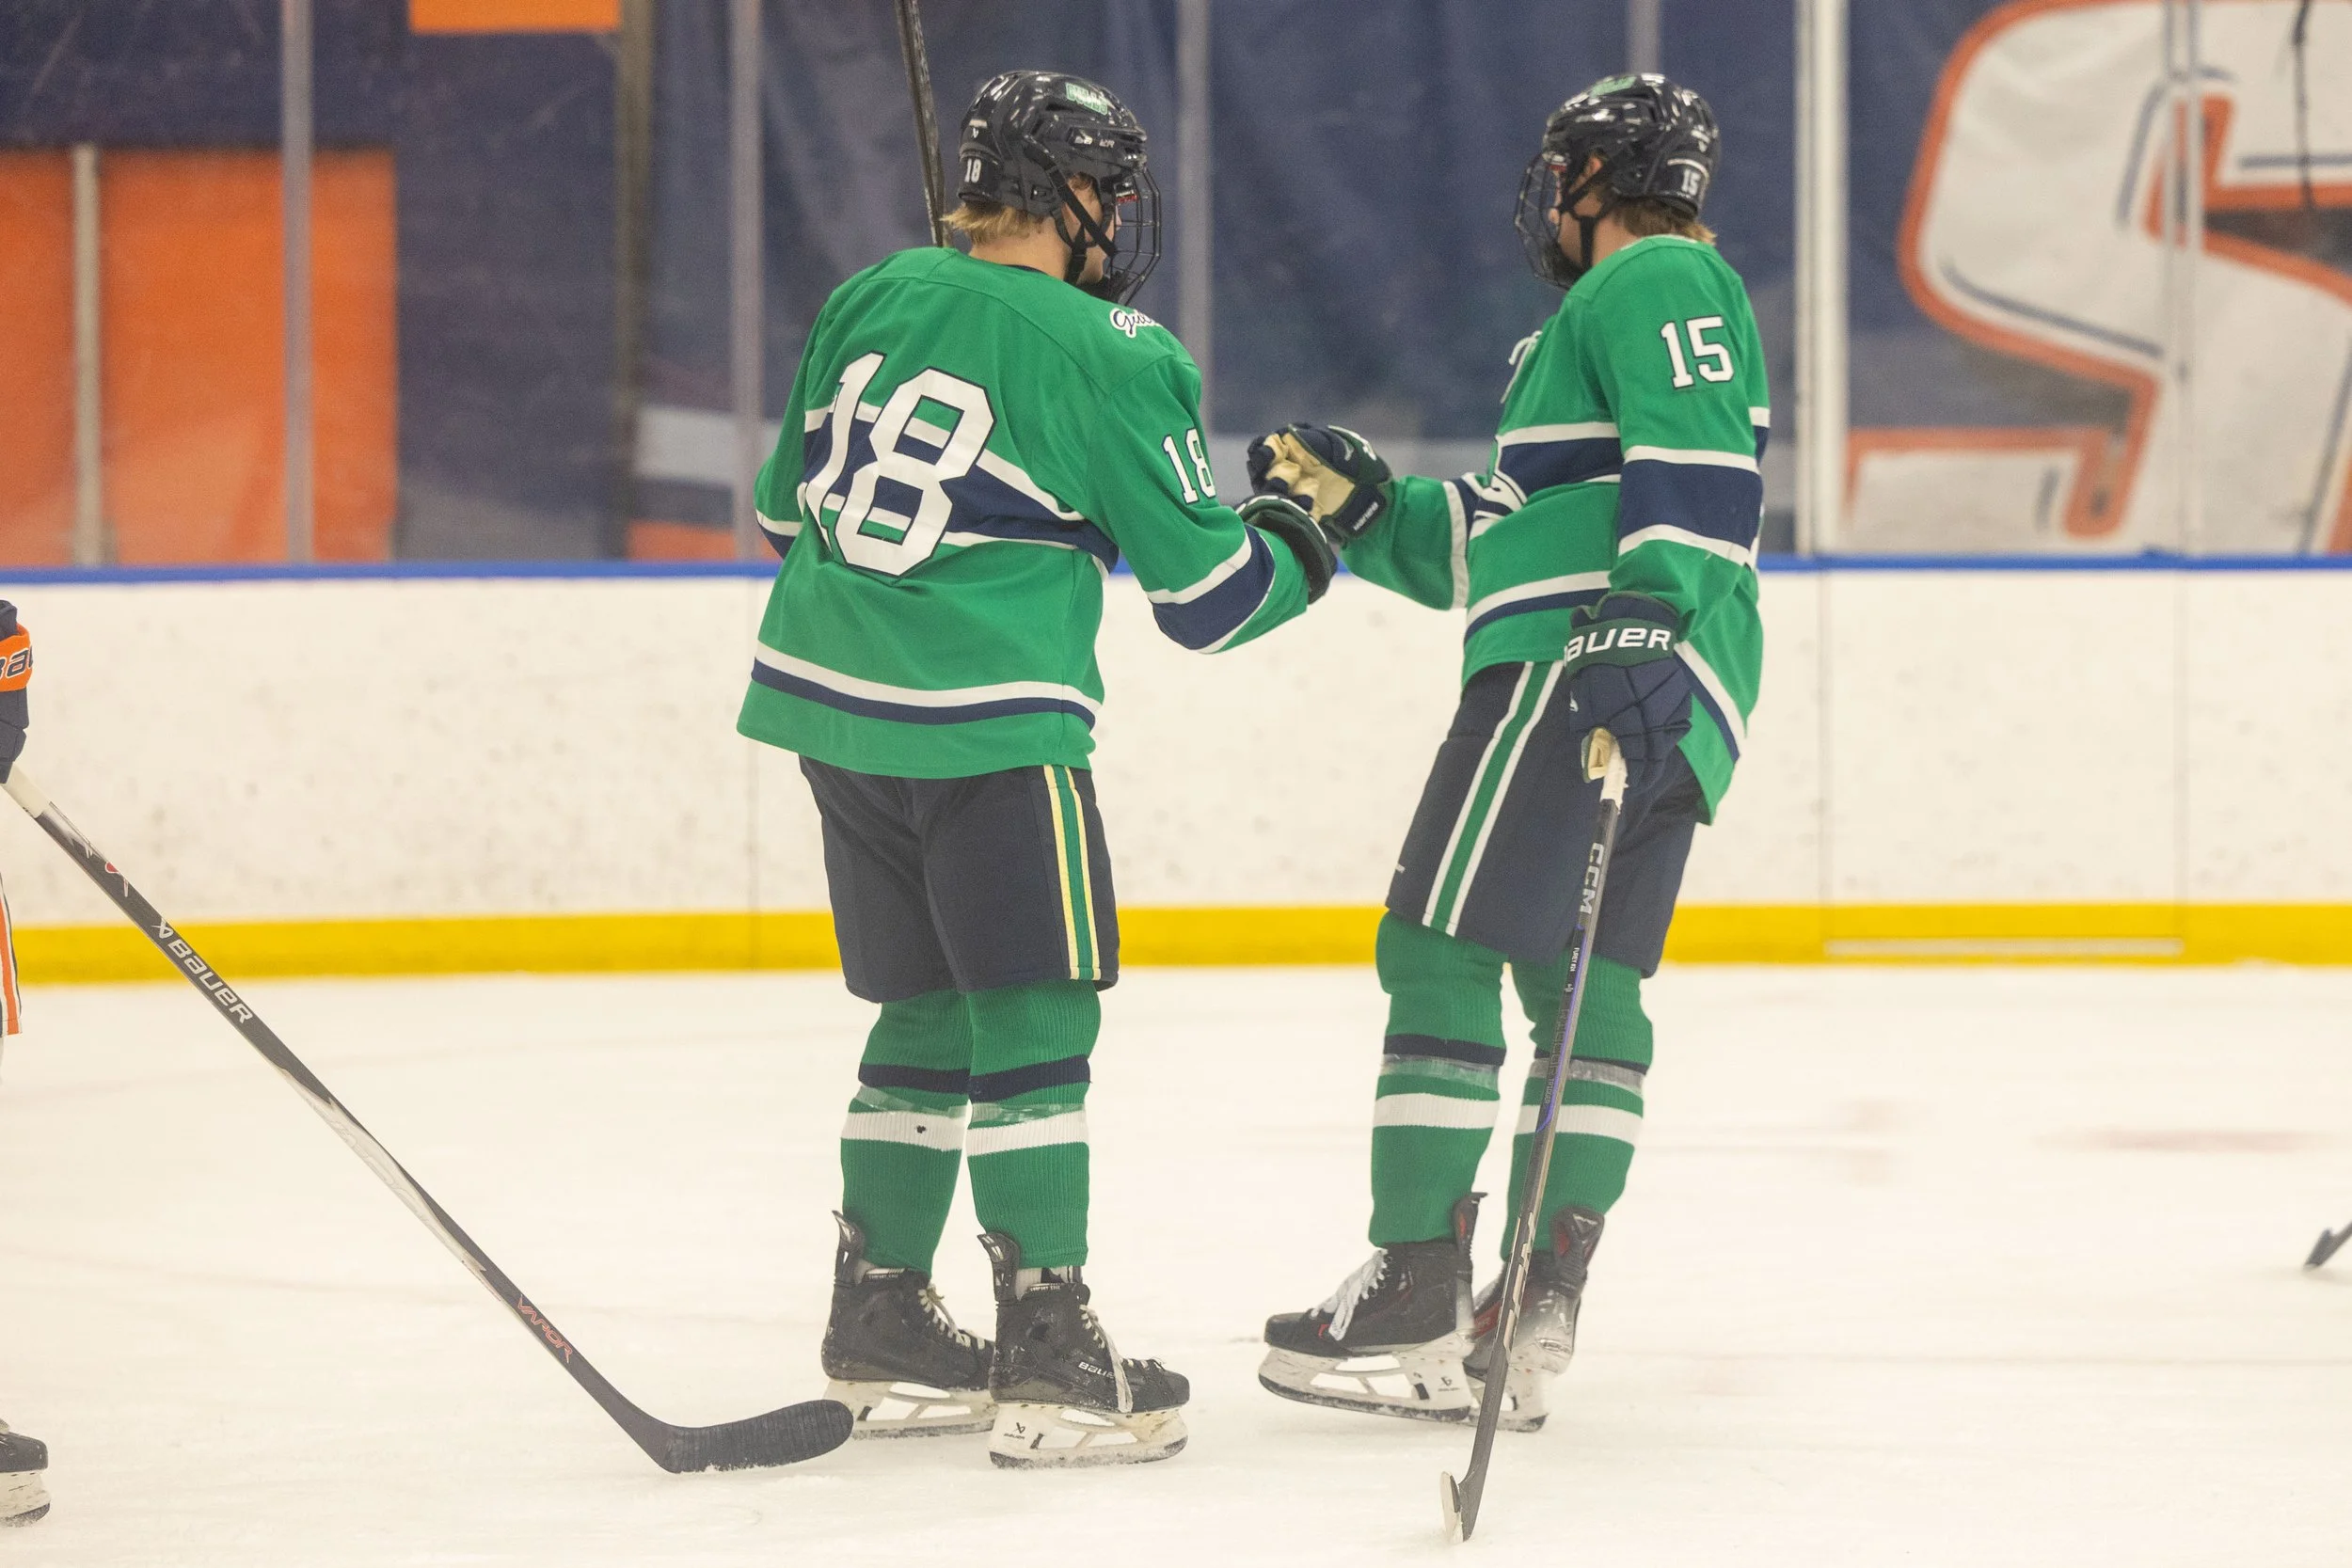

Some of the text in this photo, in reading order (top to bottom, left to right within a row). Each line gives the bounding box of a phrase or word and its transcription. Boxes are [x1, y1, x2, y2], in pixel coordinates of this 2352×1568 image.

[964, 158, 982, 183] 18
[1681, 168, 1701, 196] 15
[1660, 315, 1735, 390] 15
[800, 350, 997, 578] 18
[1162, 428, 1216, 504] 18
[1564, 627, 1671, 664] AUER
[1580, 842, 1605, 914] CCM
[167, 939, 253, 1023] BAUER
[517, 1293, 573, 1364] VAPOR
[1078, 1361, 1116, 1379] BAUE
